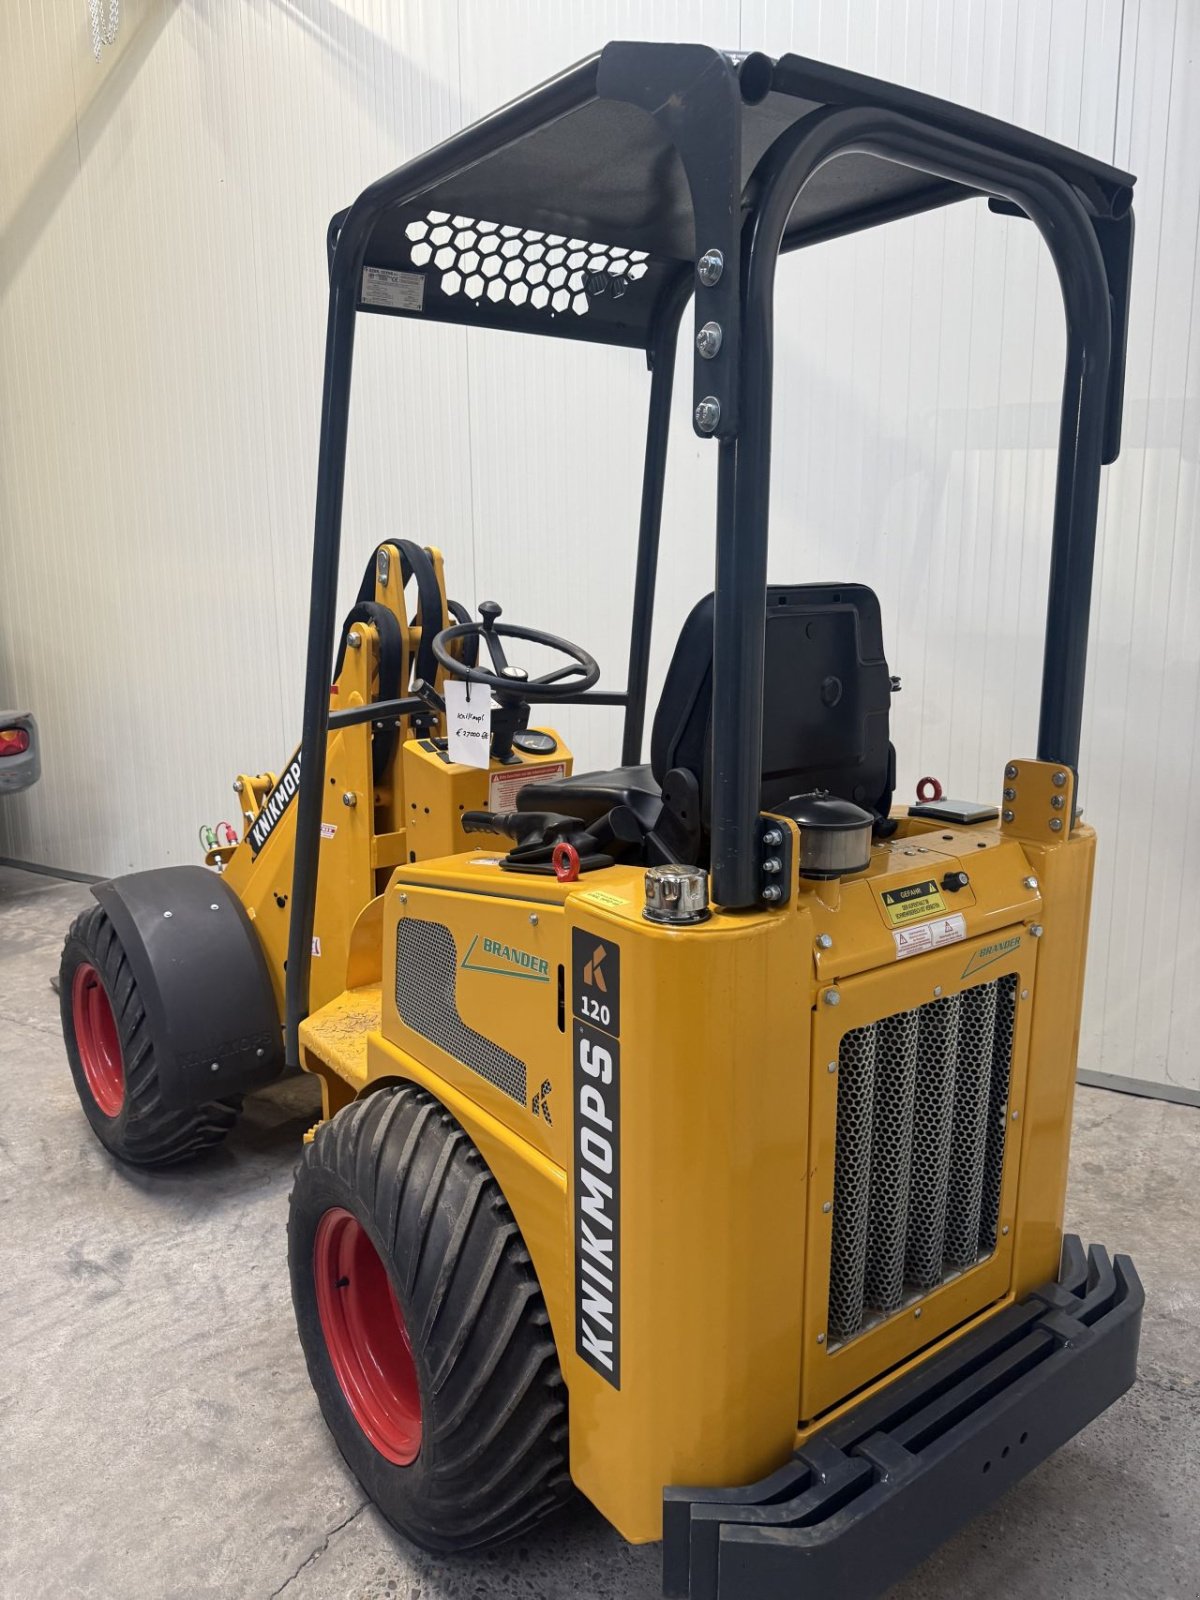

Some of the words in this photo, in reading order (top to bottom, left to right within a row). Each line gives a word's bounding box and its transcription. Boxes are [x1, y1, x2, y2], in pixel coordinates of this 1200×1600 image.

[252, 751, 302, 847] KNIKMOP
[900, 888, 922, 899] GEFAHR
[483, 937, 549, 975] BRANDER
[979, 936, 1021, 958] BRANDER
[581, 996, 610, 1025] 120
[580, 1038, 613, 1372] KNIKMOPS
